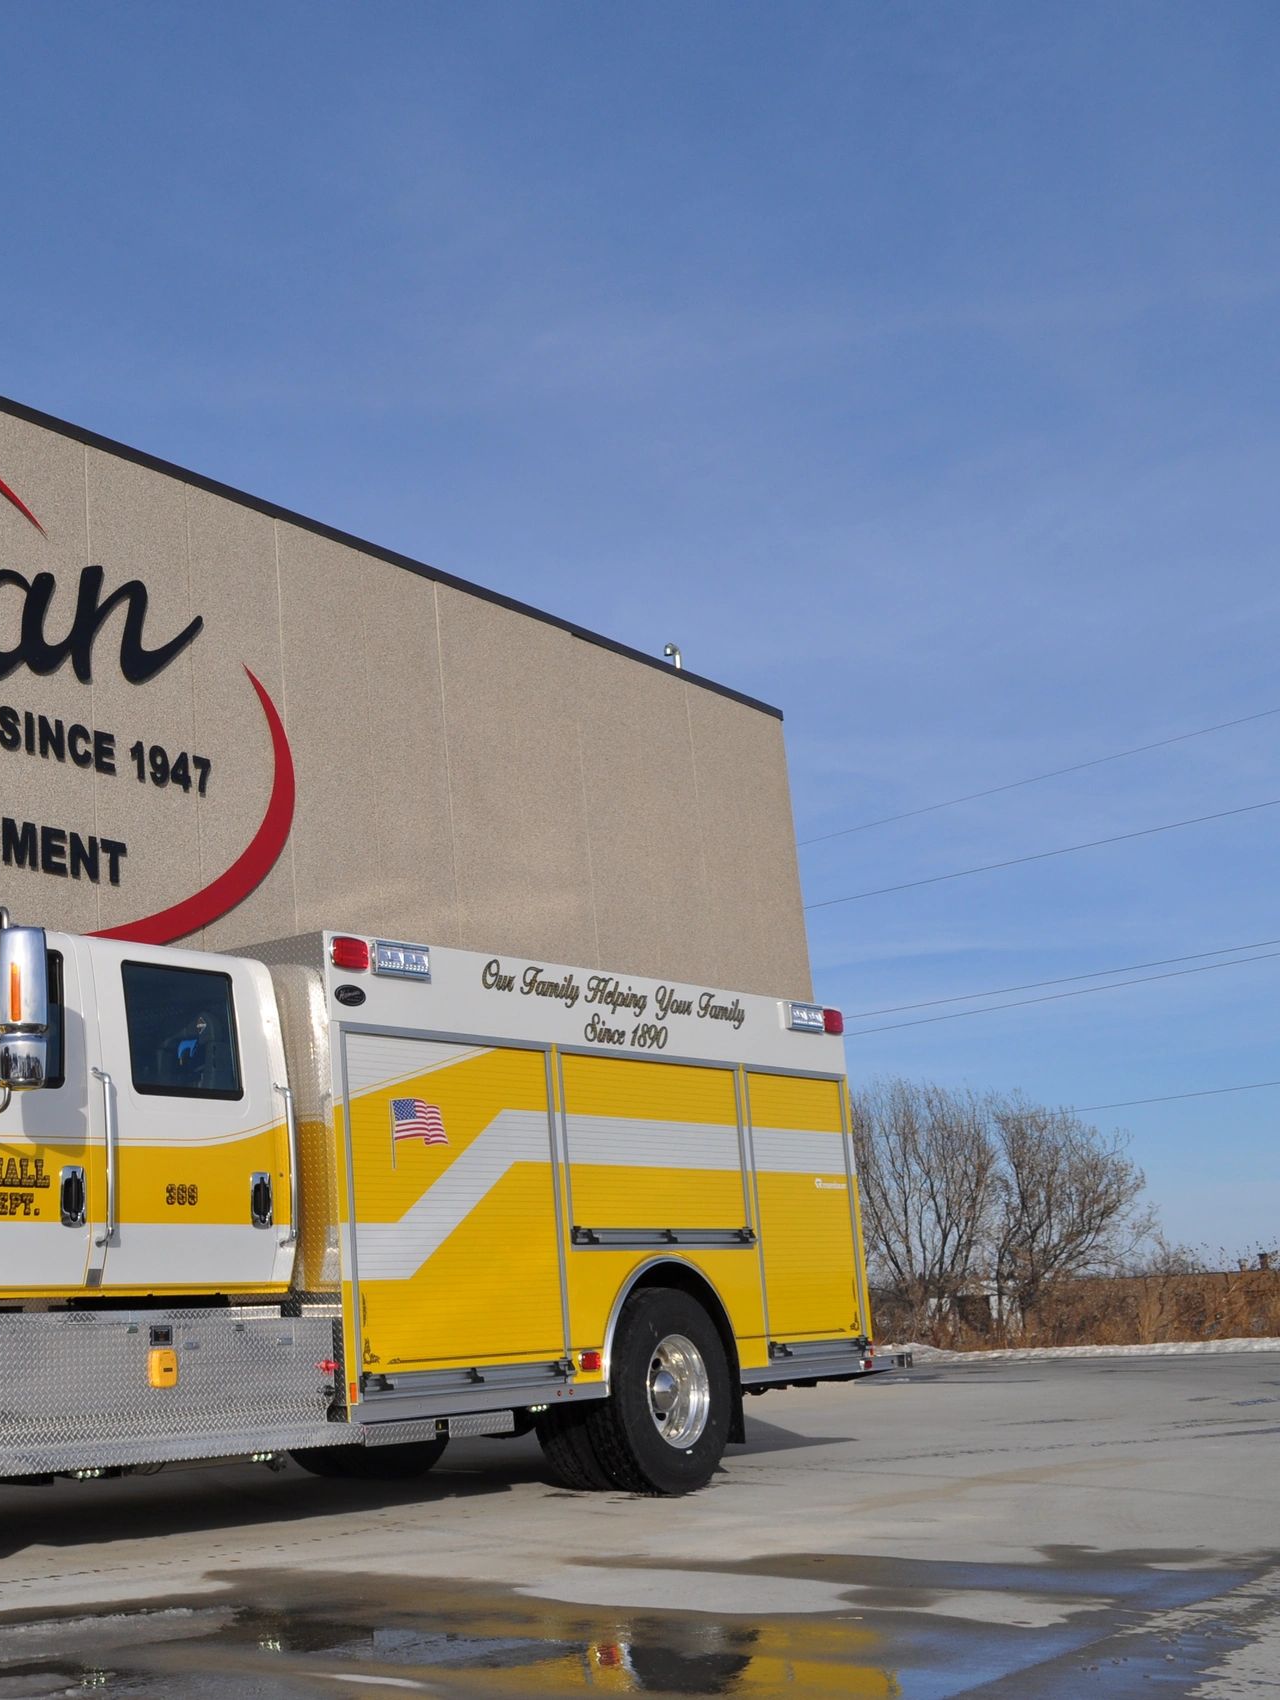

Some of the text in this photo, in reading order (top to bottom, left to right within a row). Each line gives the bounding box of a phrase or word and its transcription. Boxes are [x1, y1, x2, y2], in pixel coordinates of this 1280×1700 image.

[130, 740, 212, 796] 1947
[481, 958, 746, 1030] Our Family Helping Your Family
[584, 1013, 669, 1050] Since 1890
